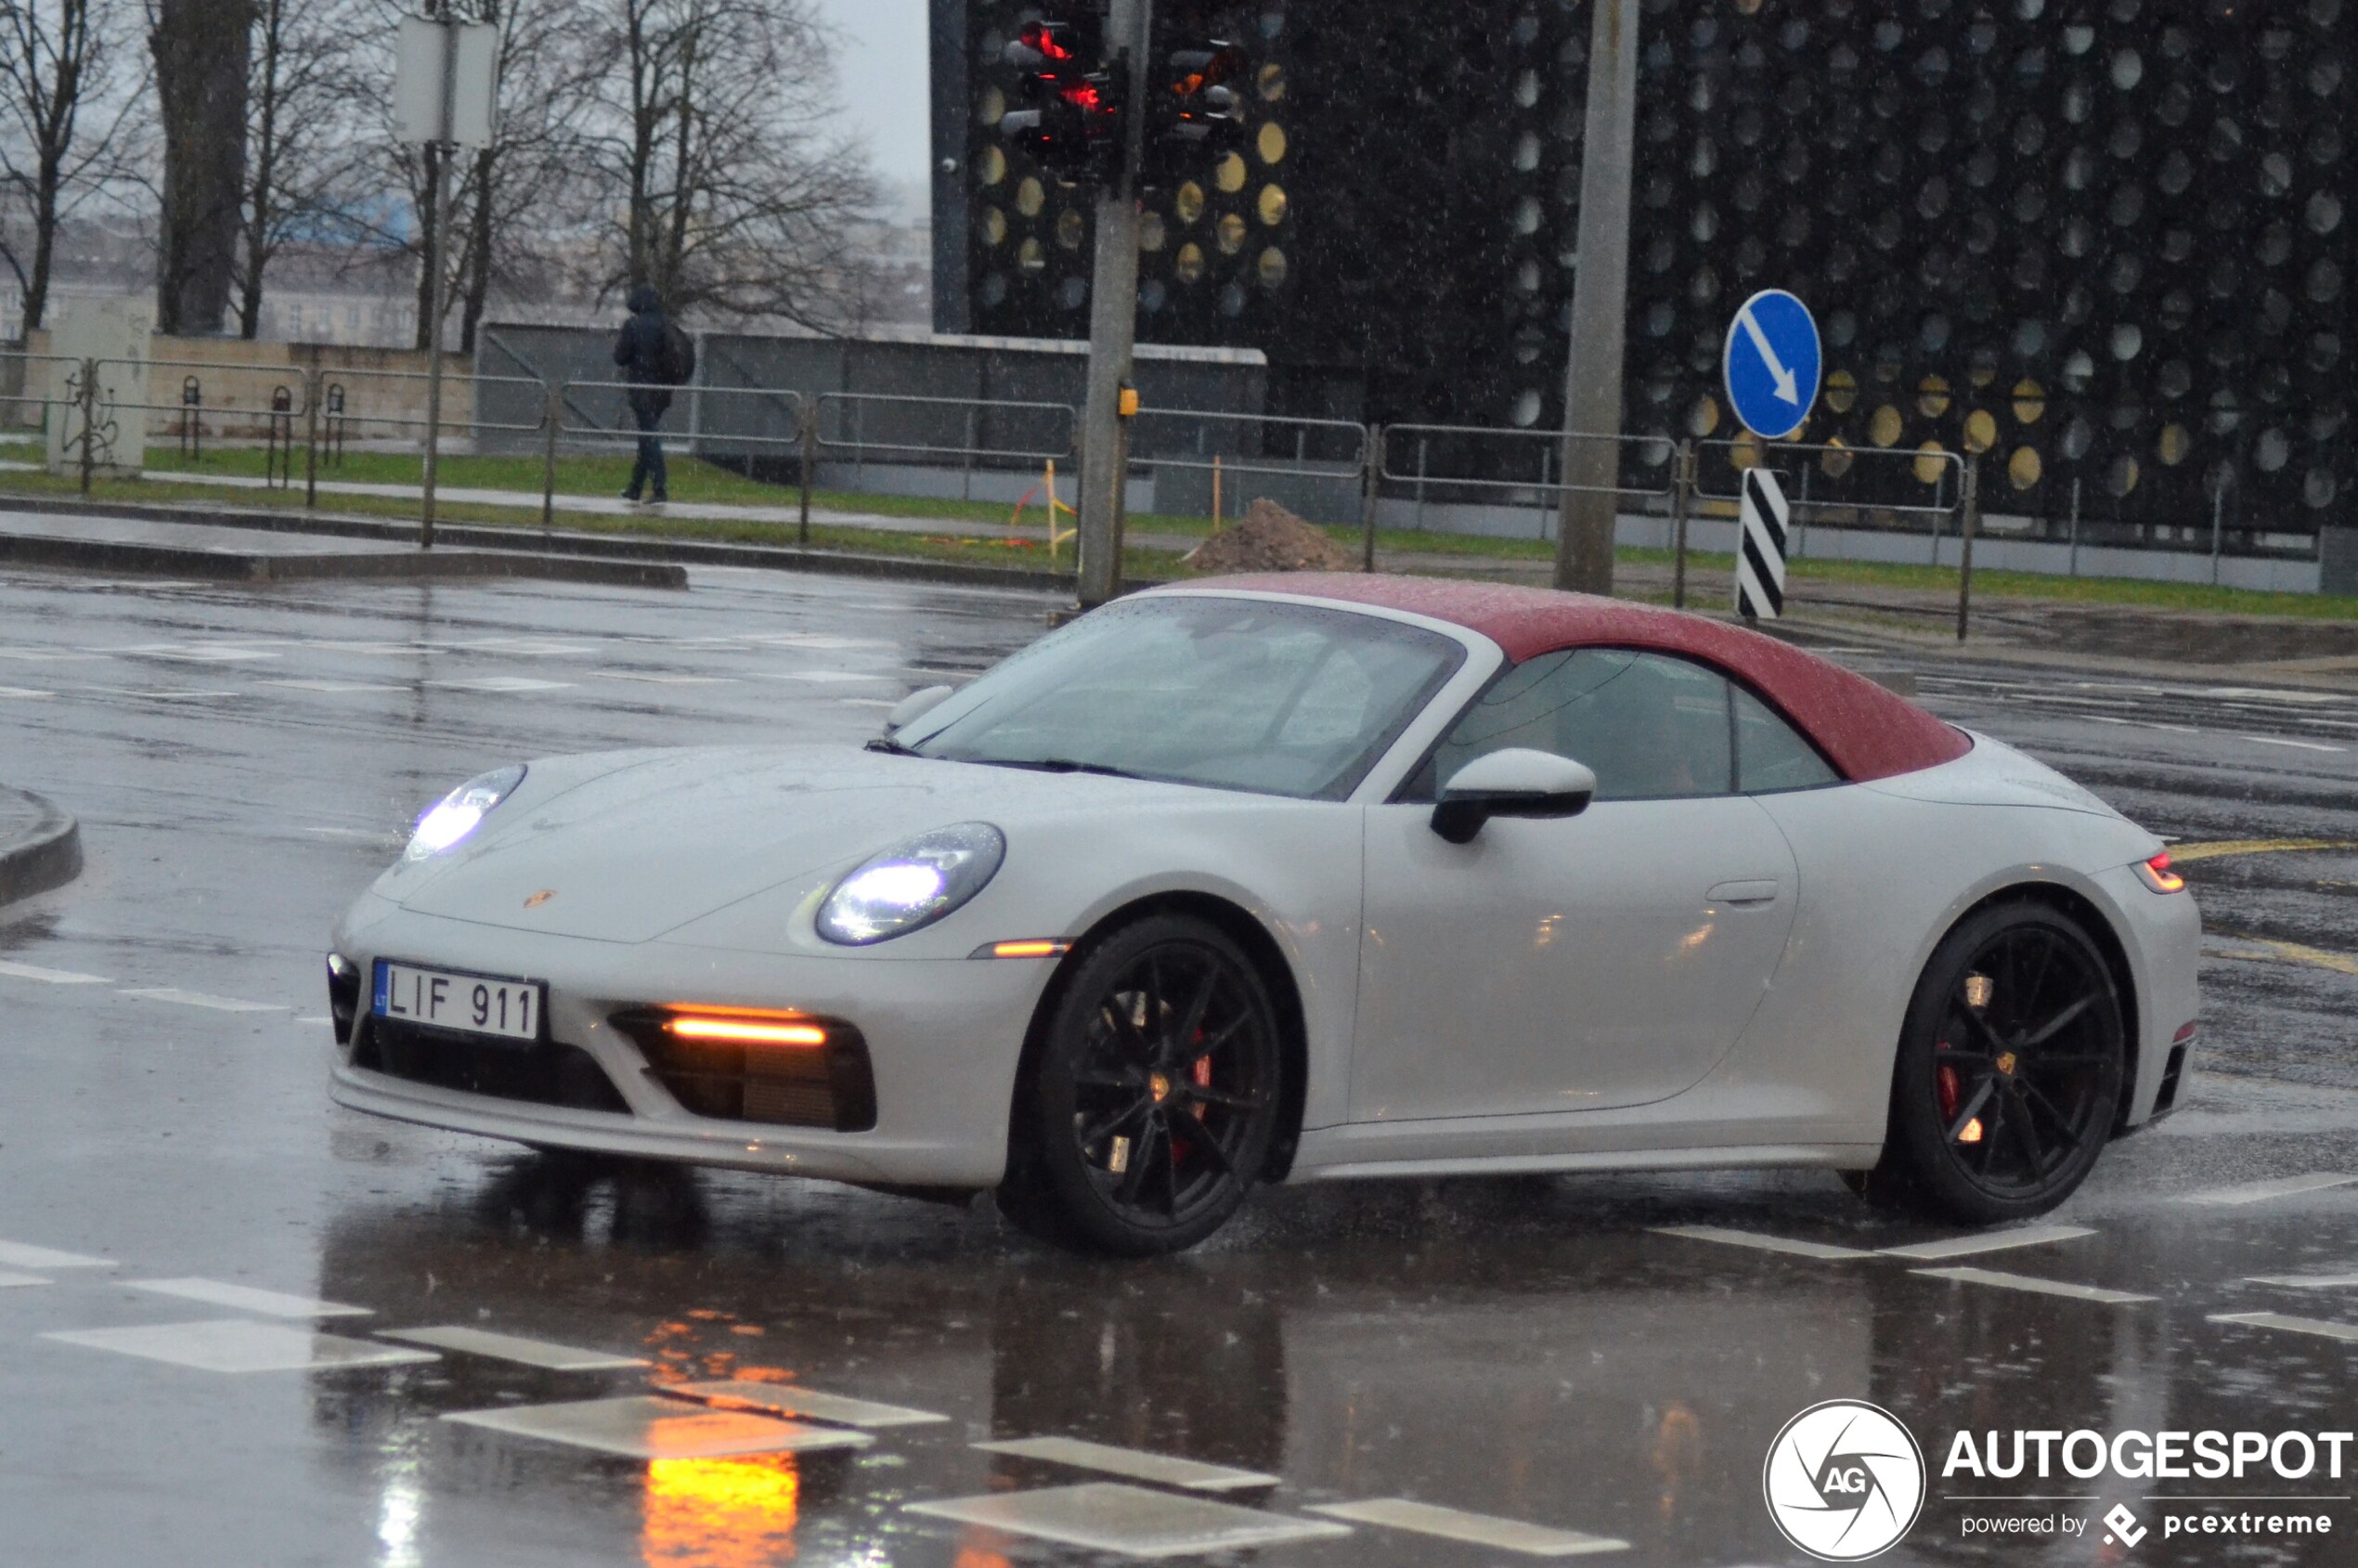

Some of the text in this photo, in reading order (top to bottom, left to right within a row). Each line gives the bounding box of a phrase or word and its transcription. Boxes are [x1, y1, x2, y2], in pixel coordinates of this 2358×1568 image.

[375, 994, 386, 1006] LT
[391, 970, 529, 1032] LIF 911
